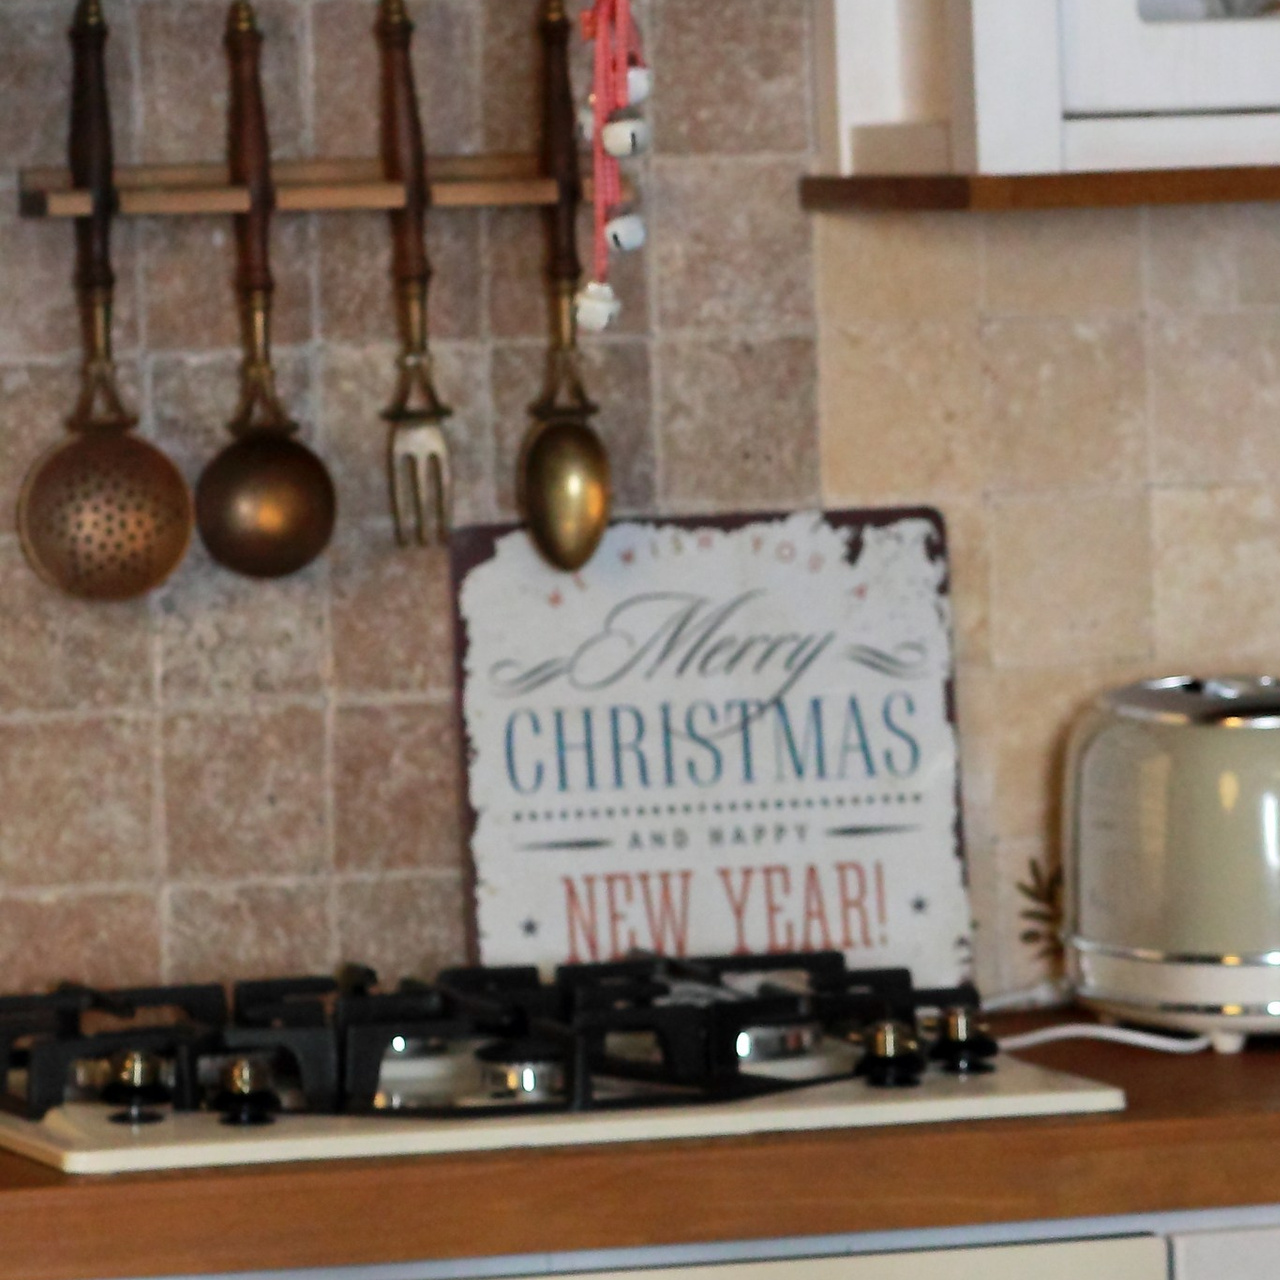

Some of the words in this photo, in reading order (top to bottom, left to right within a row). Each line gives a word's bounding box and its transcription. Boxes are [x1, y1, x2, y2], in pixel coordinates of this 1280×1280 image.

[568, 587, 837, 741] Merry
[504, 689, 922, 795] CHRISTMAS
[628, 827, 689, 849] AND
[708, 823, 809, 848] HAPPY
[560, 869, 695, 965] NEW
[716, 860, 889, 957] YEAR!
